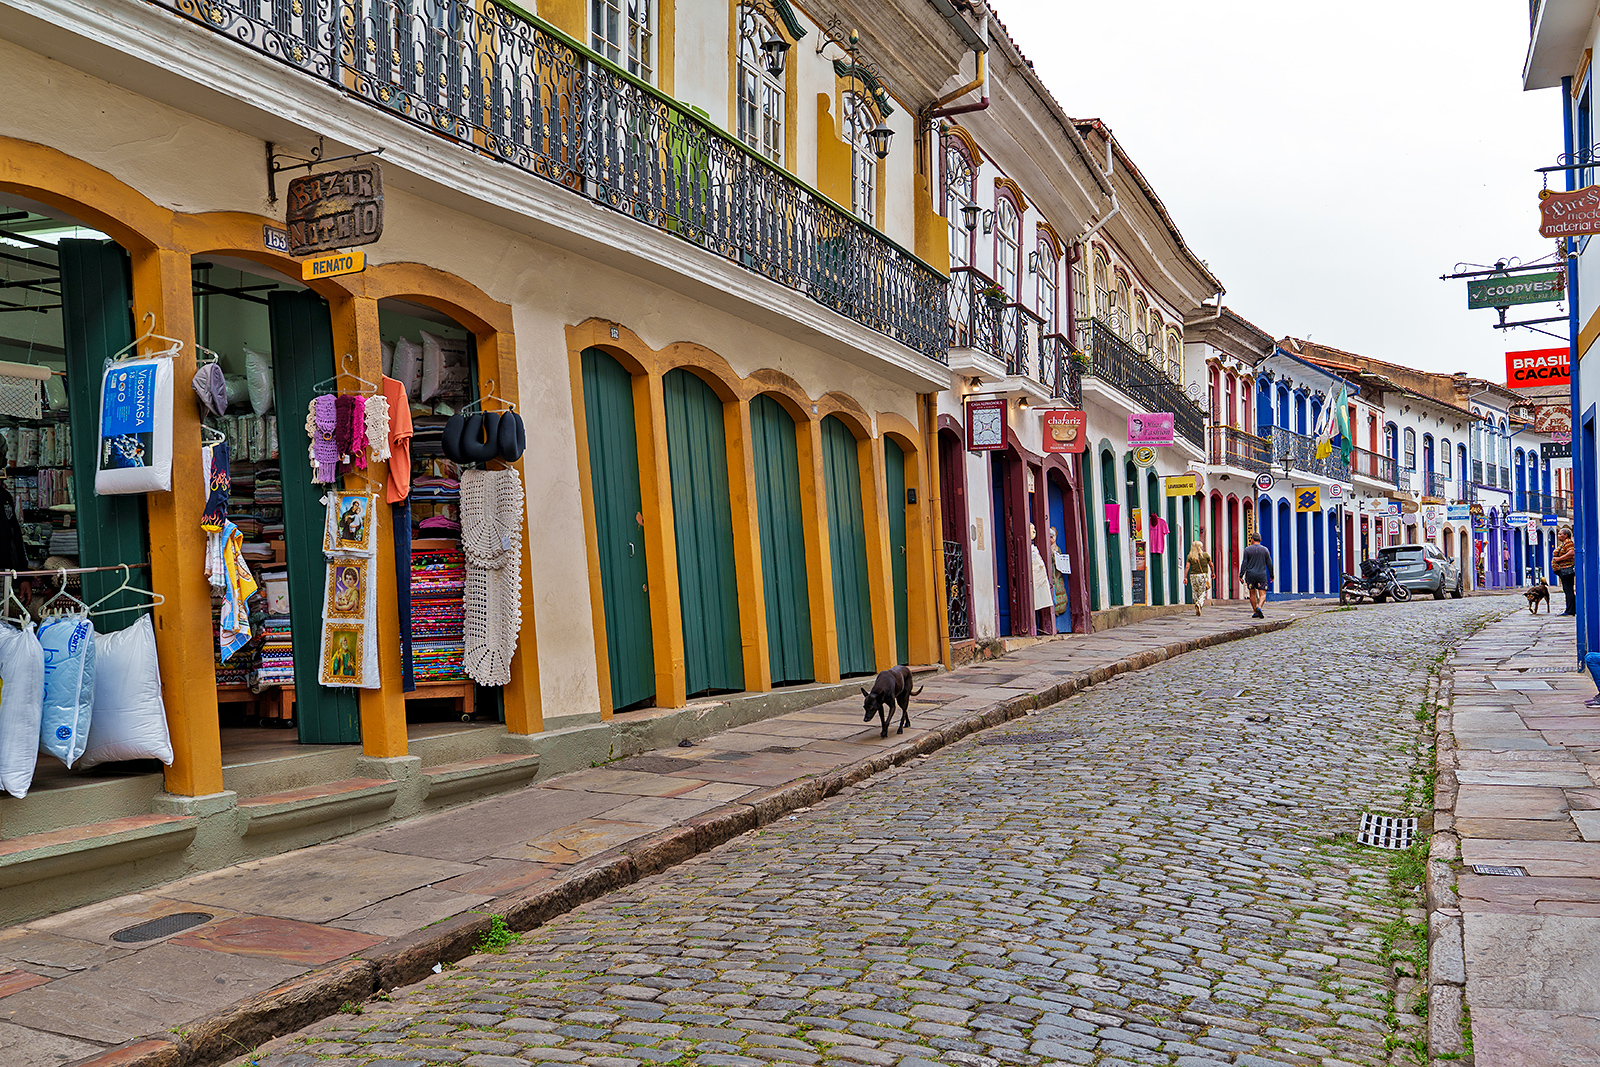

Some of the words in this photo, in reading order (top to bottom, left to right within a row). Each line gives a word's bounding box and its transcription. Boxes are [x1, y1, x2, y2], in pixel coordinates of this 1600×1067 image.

[291, 174, 372, 210] BAZAR
[1545, 221, 1591, 233] material
[267, 230, 287, 249] 153
[313, 256, 353, 275] RENATO
[1513, 355, 1570, 369] BRASIL
[1514, 366, 1570, 380] CACAU
[1047, 412, 1081, 425] chafariz
